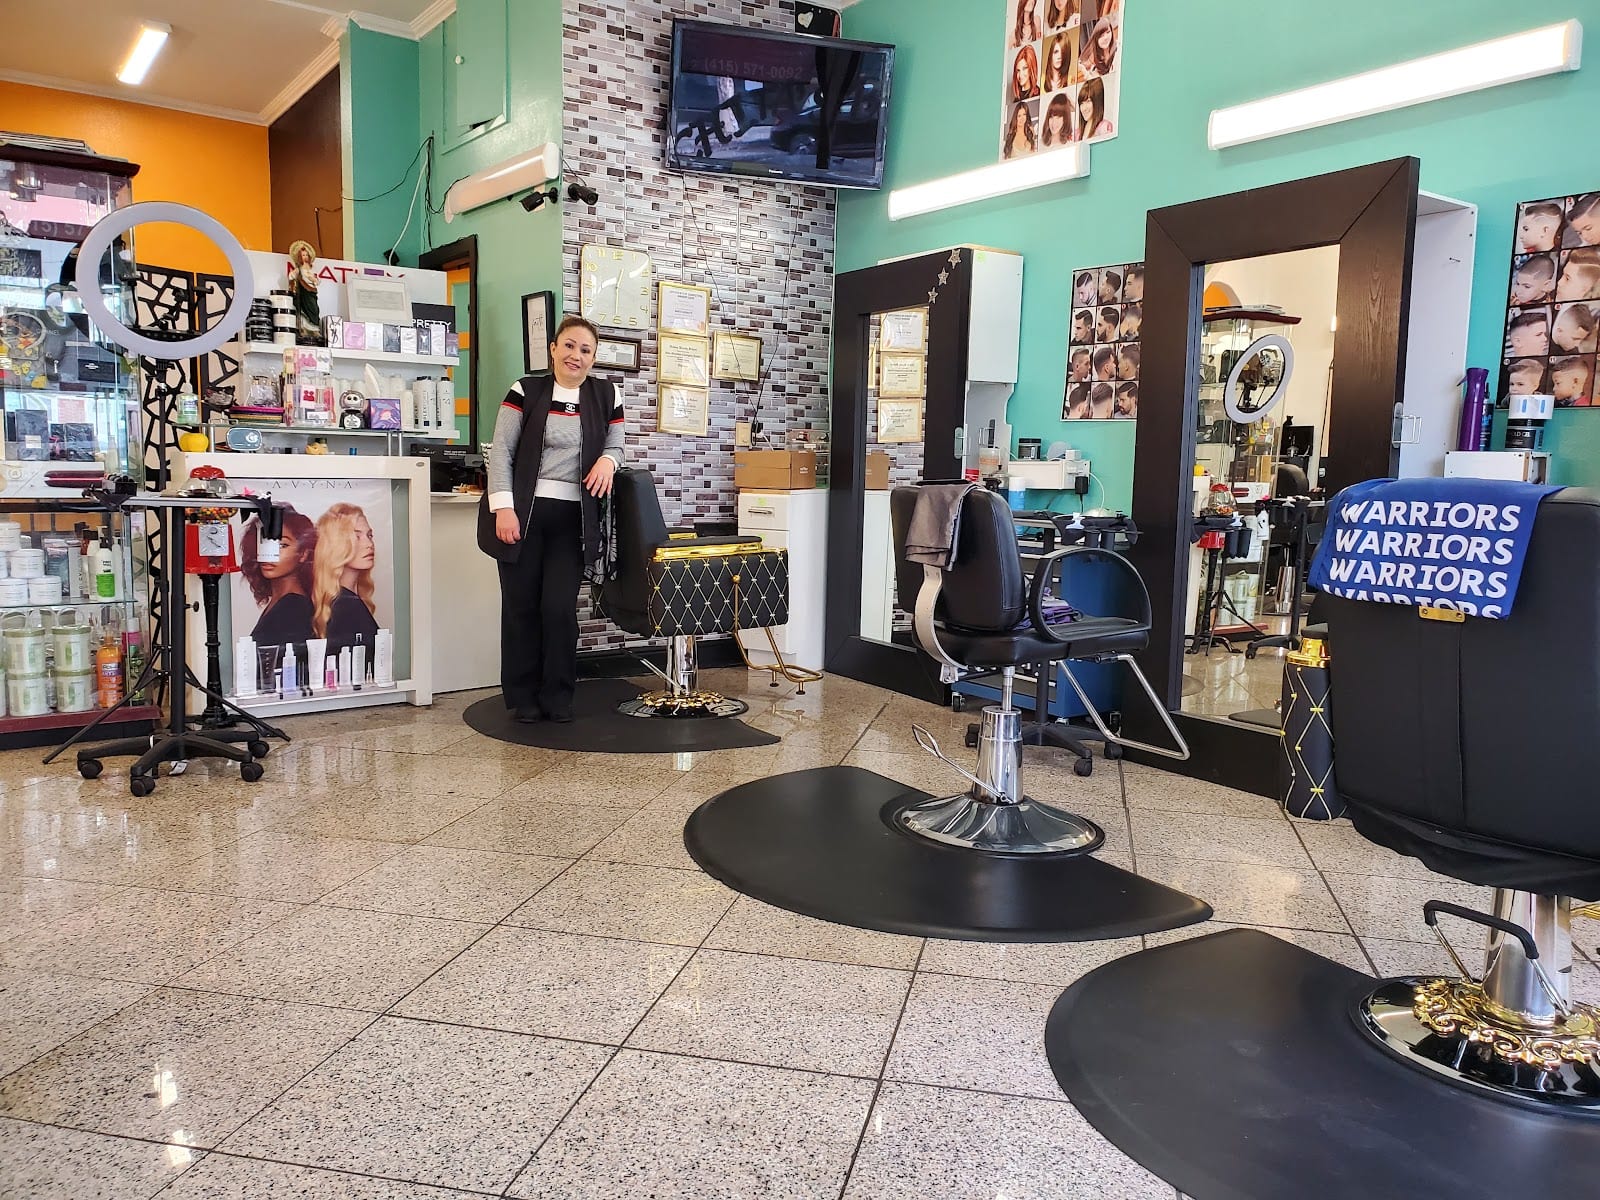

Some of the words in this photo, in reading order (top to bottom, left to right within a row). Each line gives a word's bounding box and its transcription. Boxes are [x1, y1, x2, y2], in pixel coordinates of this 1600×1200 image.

[704, 57, 738, 75] (415)
[743, 62, 802, 79] 571-0092
[1341, 500, 1521, 532] WARRIORS
[1335, 528, 1514, 566] WARRIORS
[1328, 557, 1508, 599] WARRIORS
